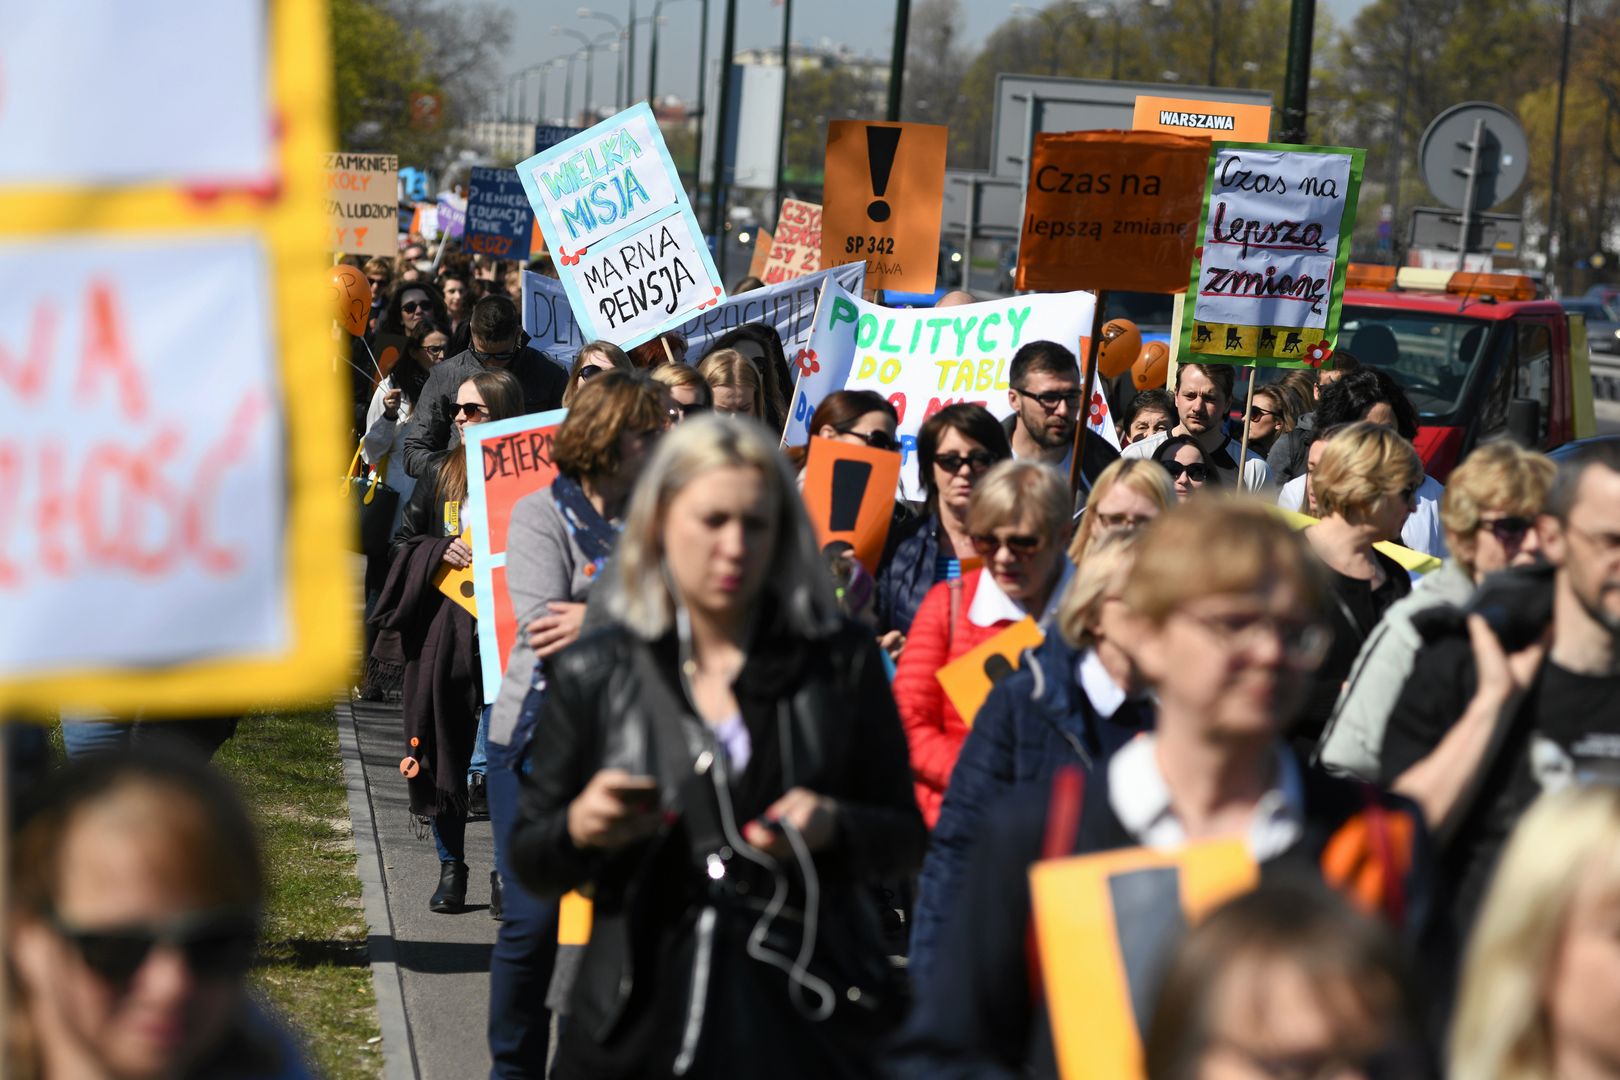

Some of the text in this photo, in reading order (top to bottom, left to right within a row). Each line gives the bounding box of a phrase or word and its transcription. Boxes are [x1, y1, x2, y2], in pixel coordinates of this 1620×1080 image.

[1160, 111, 1235, 130] WARSZAWA
[1035, 164, 1162, 196] Czas na
[1219, 156, 1340, 199] Czas na
[468, 204, 527, 226] EDUKACJA
[561, 166, 651, 241] MISJA
[1028, 213, 1103, 241] lepszą
[583, 225, 681, 294] MARNA
[845, 236, 895, 255] SP 342
[599, 256, 696, 329] PENSJA
[829, 296, 1032, 357] POLITYCY
[857, 356, 902, 384] DO
